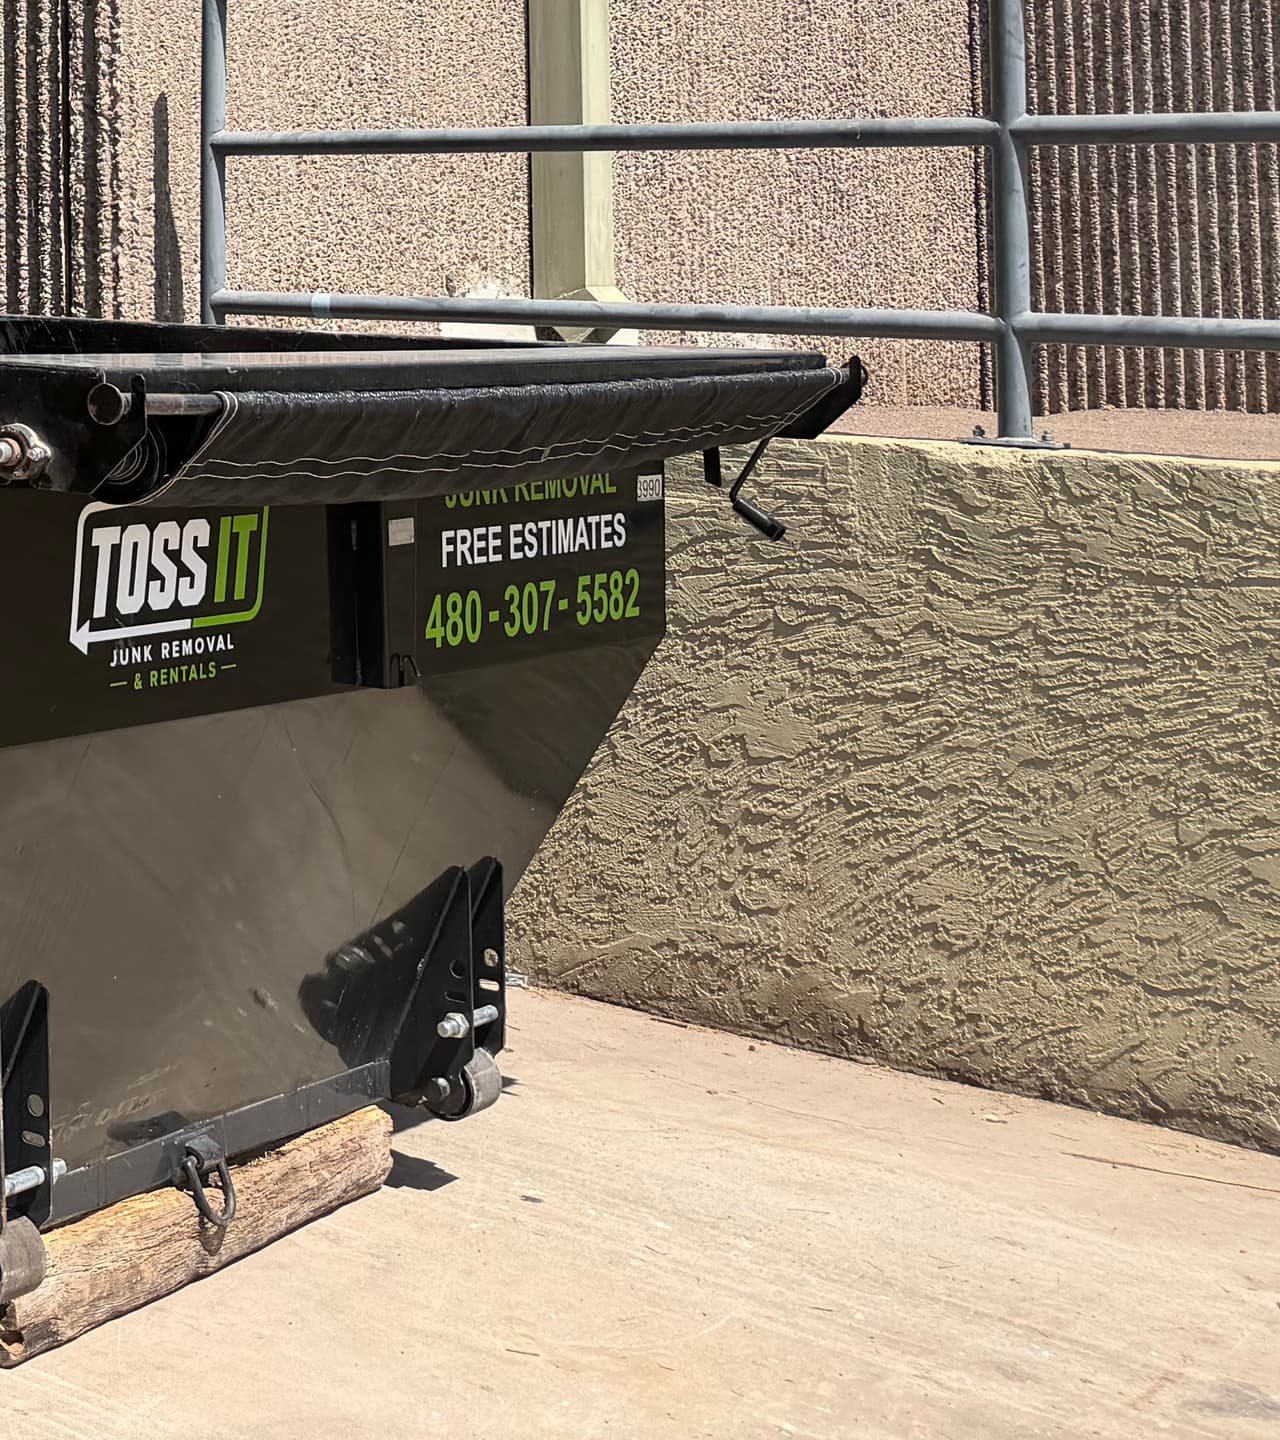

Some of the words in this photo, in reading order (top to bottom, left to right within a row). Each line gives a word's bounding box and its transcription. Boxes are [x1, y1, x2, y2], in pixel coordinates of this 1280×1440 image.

[441, 525, 503, 568] FREE
[509, 512, 627, 561] ESTIMATES
[91, 518, 211, 618] TOSS
[213, 513, 259, 603] IT
[110, 644, 153, 667] JUNK
[161, 633, 235, 659] REMOVAL
[133, 673, 143, 690] &
[150, 661, 217, 688] RENTALS
